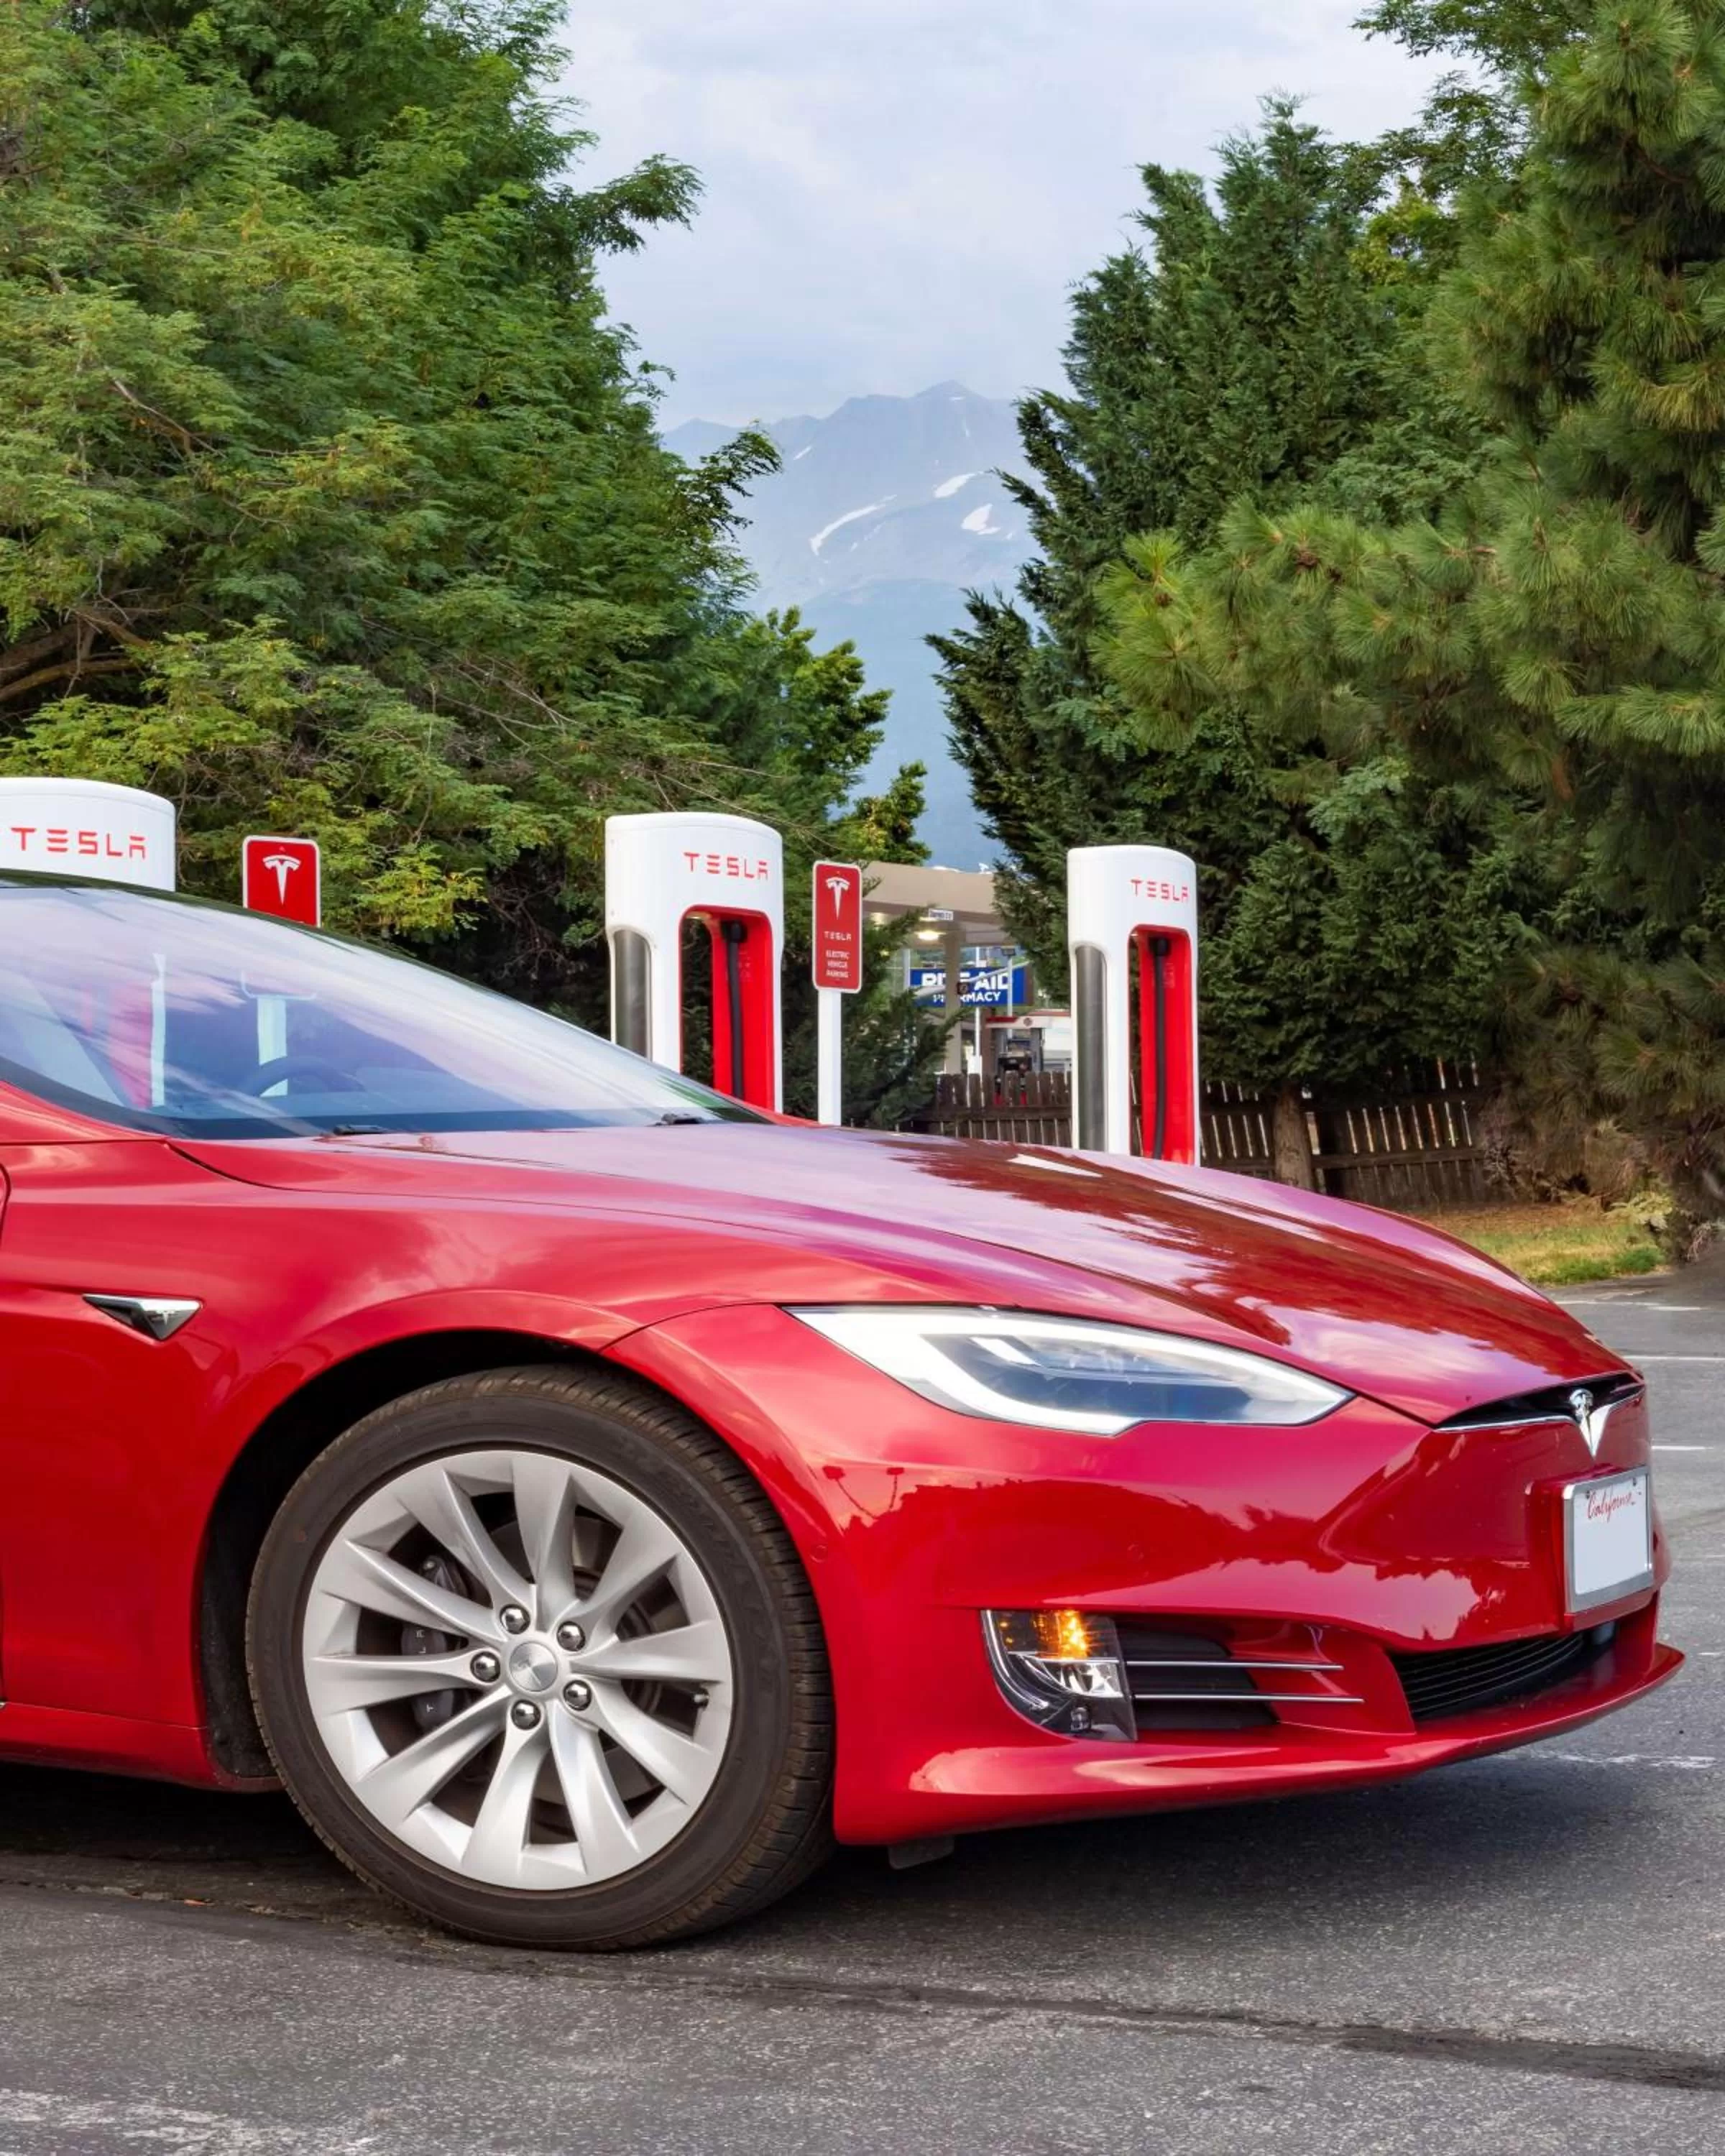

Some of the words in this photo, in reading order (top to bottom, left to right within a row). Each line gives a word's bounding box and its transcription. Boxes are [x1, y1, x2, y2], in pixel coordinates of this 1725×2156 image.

[11, 827, 146, 860] TESLA
[684, 852, 768, 881] TESLA
[1131, 878, 1188, 903] TESLA
[824, 931, 852, 941] TESLA
[974, 971, 1008, 990] AID
